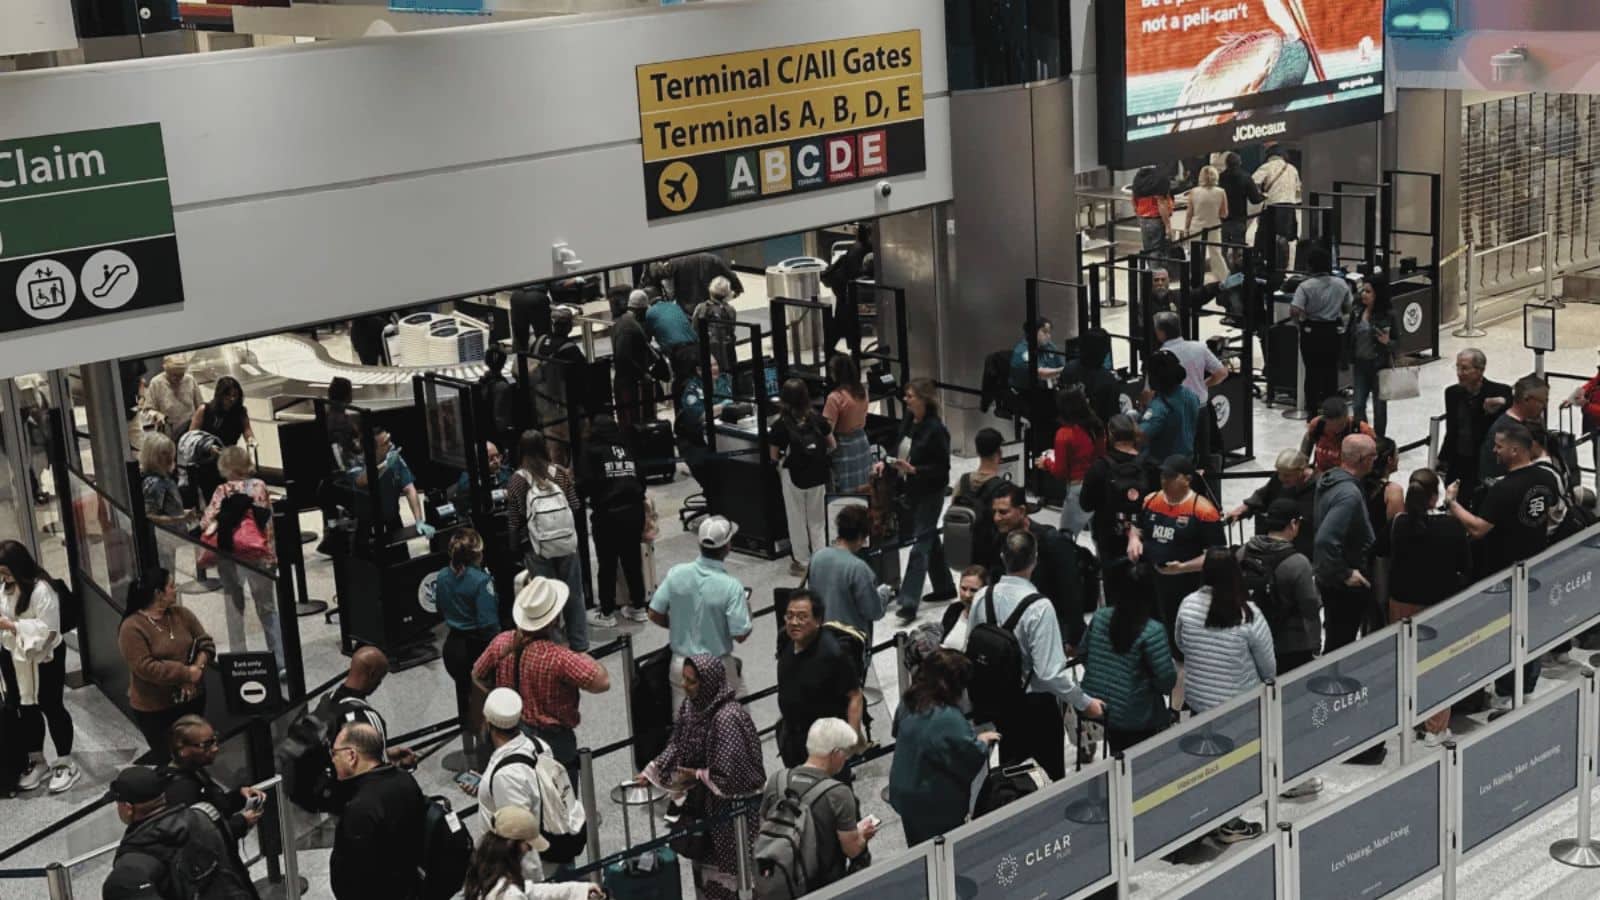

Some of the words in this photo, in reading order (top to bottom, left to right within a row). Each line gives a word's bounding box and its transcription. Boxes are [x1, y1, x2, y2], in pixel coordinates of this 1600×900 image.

[1142, 13, 1168, 33] not
[1170, 15, 1180, 30] a
[1183, 3, 1249, 32] peli-can't
[650, 58, 770, 102] Terminal
[777, 49, 837, 84] C/All
[843, 46, 912, 75] Gates
[653, 104, 791, 150] Terminals
[799, 100, 825, 129] A,
[833, 95, 857, 124] B,
[864, 90, 890, 119] D,
[897, 85, 911, 112] E
[1233, 121, 1287, 143] JCDecaux
[0, 145, 106, 188] Claim
[730, 155, 755, 190] A
[764, 151, 787, 184] B
[797, 144, 820, 177] C
[829, 139, 852, 172] D
[862, 133, 883, 167] E
[1566, 571, 1592, 592] CLEAR
[1333, 686, 1368, 712] CLEAR
[1025, 834, 1071, 866] CLEAR
[1331, 860, 1346, 872] Less
[1374, 835, 1390, 848] More
